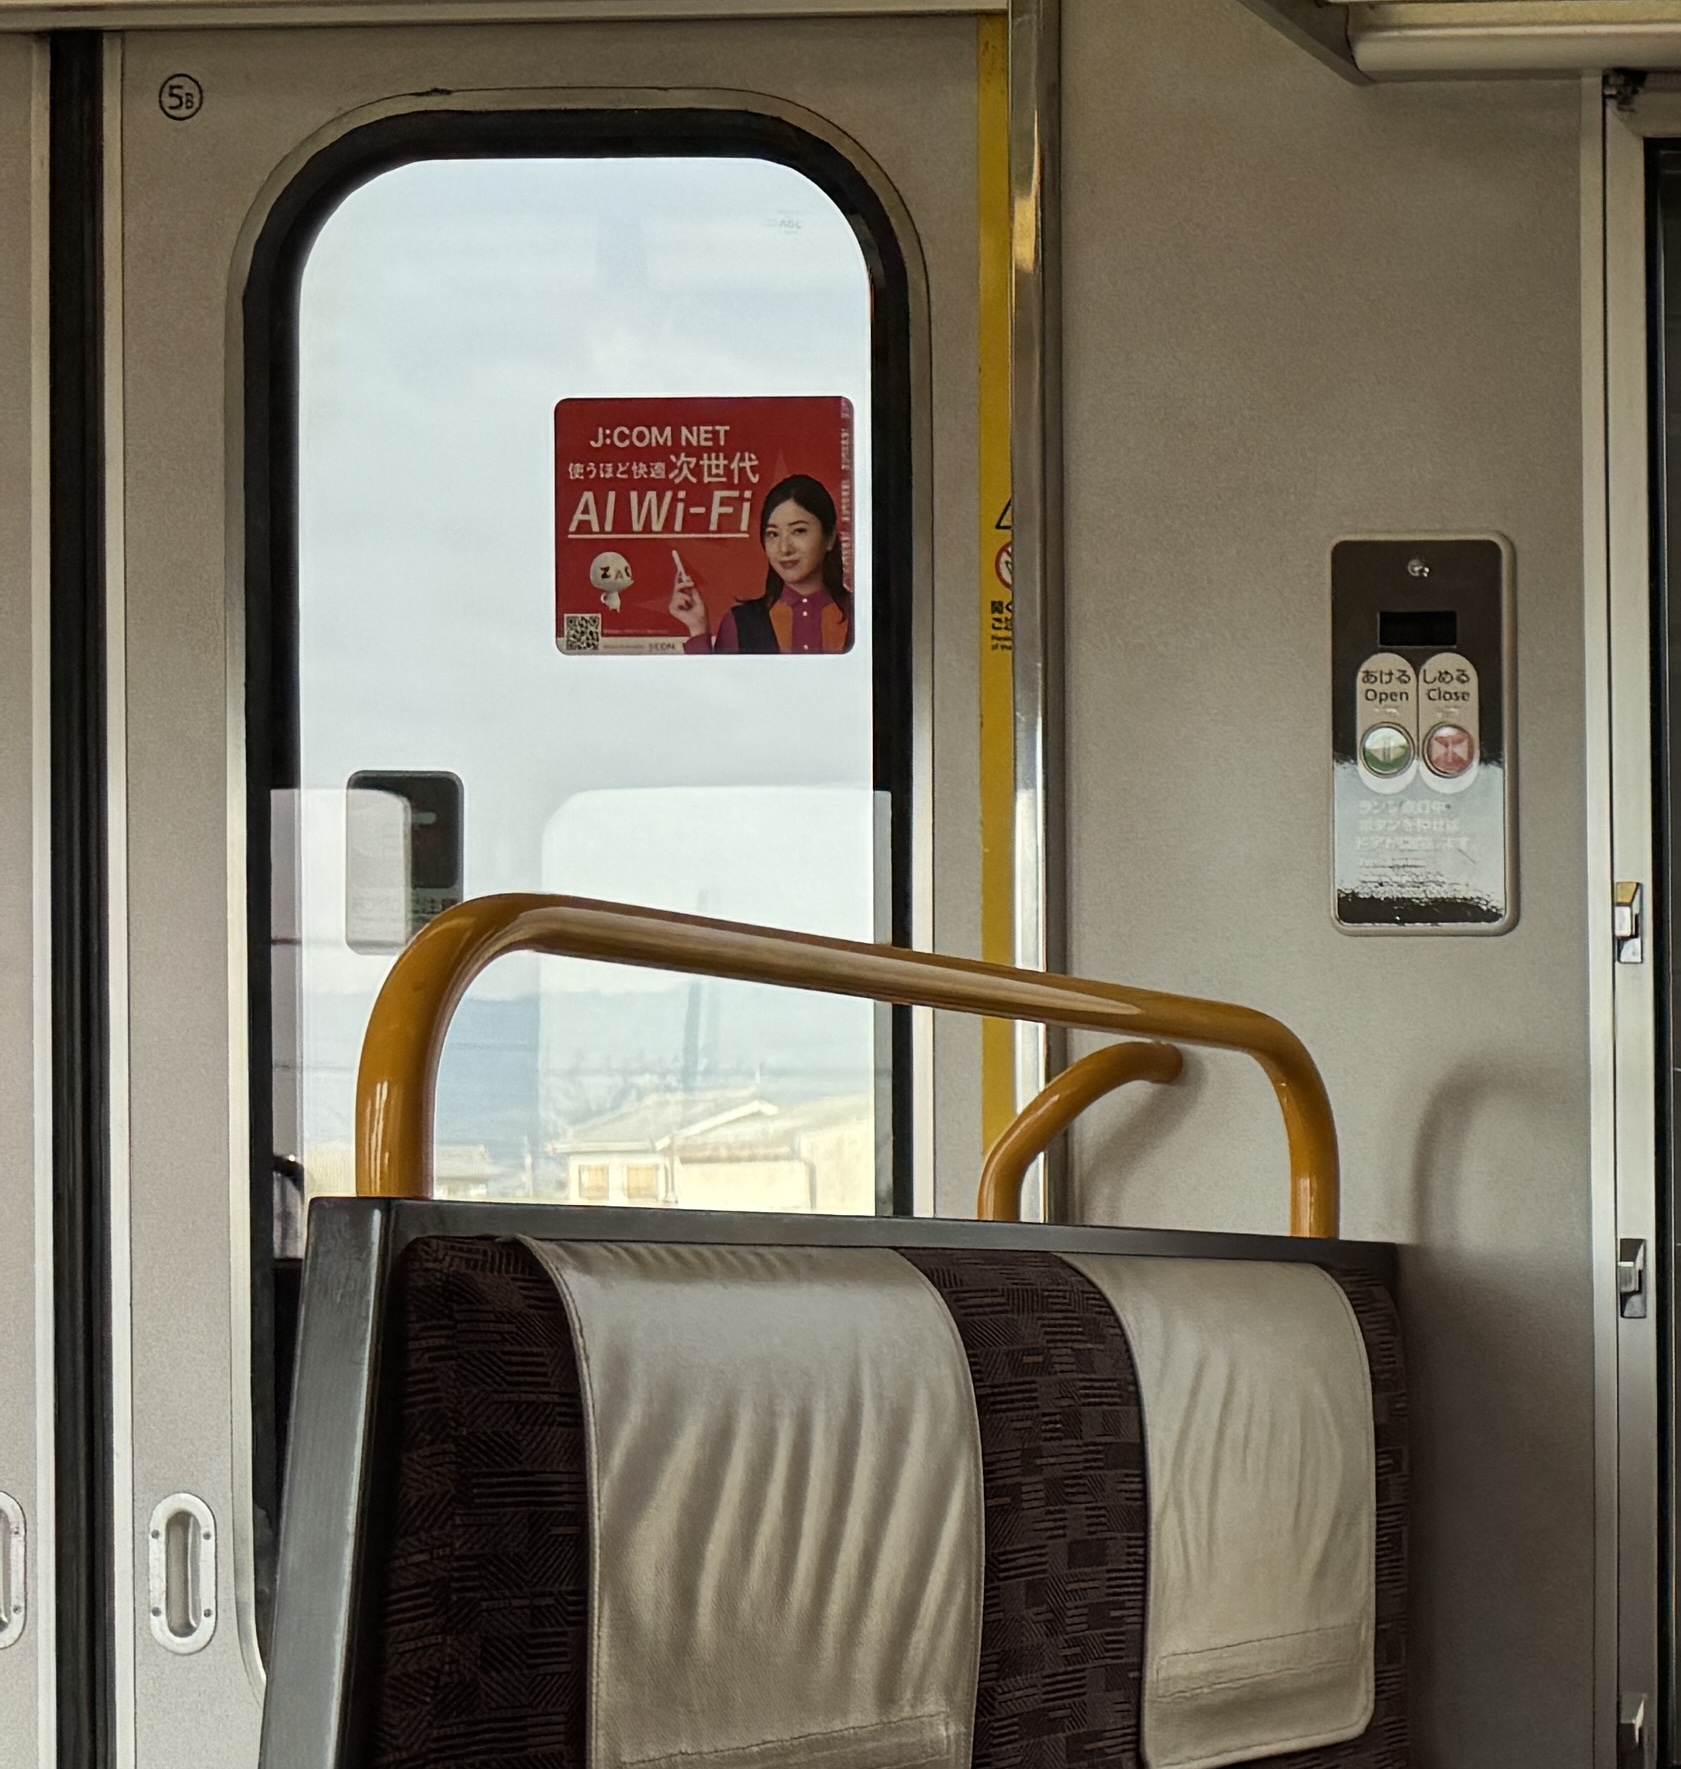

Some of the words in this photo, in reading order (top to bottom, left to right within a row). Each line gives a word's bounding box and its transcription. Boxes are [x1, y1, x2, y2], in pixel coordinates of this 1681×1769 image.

[589, 425, 672, 449] J:COM
[680, 425, 730, 447] NET
[567, 489, 617, 533] AI
[629, 489, 753, 533] Wi-Fi
[1361, 668, 1411, 685] あける
[1422, 668, 1471, 685] しめる
[1364, 688, 1410, 705] Open
[1427, 687, 1471, 702] Close
